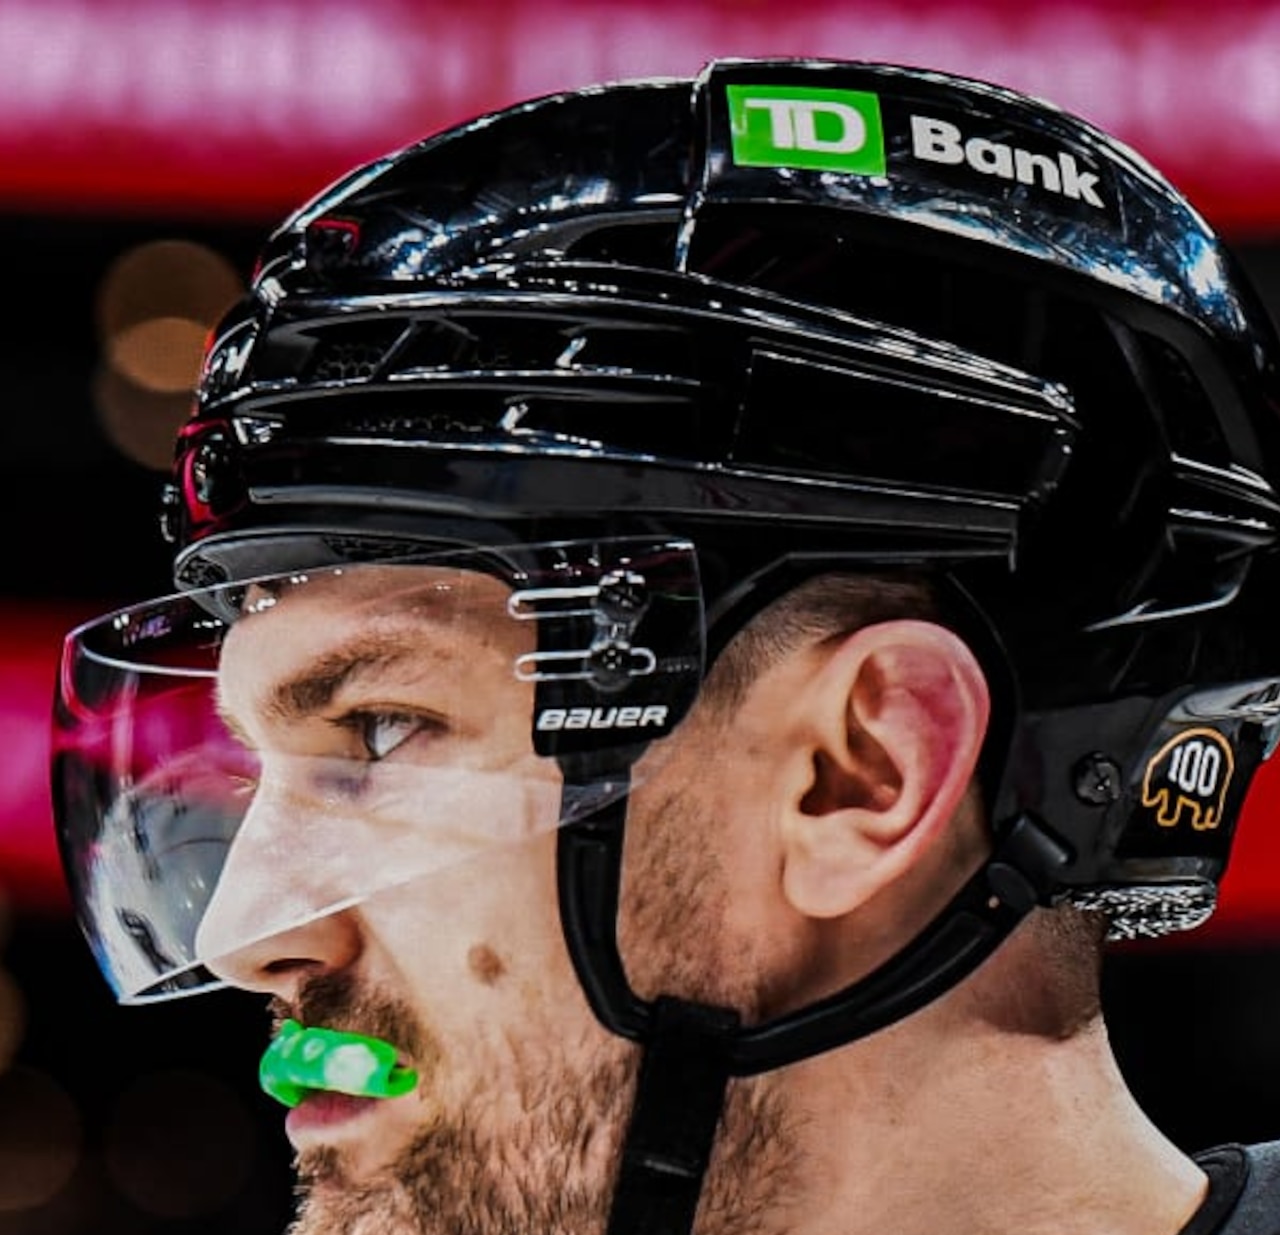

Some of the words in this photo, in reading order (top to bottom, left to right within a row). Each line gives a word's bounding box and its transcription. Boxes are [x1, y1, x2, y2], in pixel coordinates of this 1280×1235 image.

[743, 97, 866, 154] TD
[910, 114, 1105, 208] Bank
[1167, 740, 1221, 797] 100
